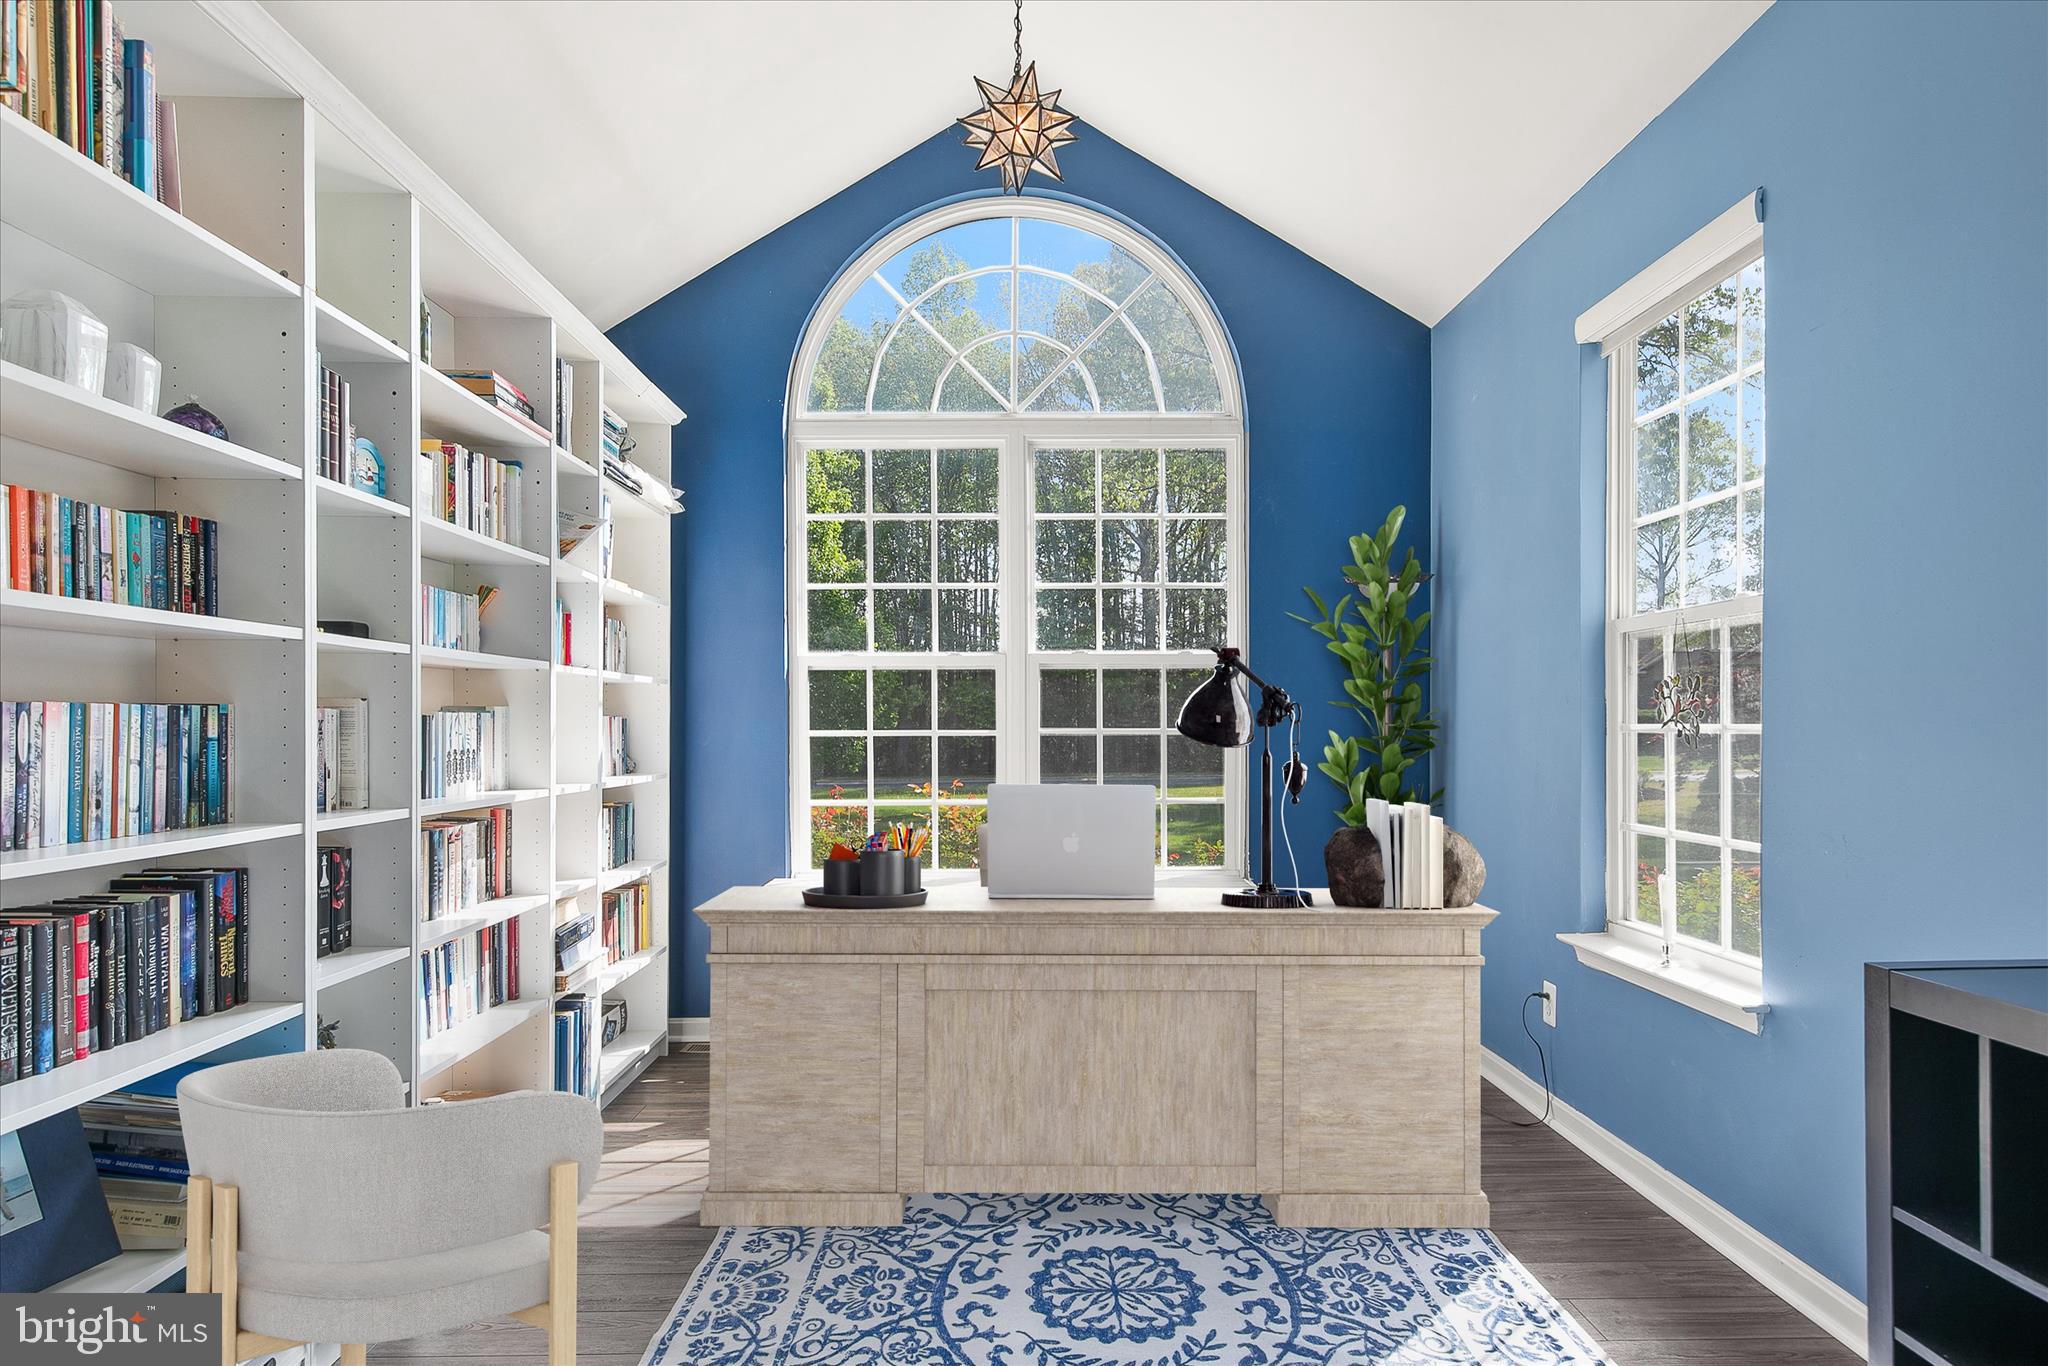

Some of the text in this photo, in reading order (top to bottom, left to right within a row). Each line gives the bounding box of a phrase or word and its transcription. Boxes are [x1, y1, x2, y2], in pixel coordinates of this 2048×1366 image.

[105, 47, 114, 169] GREAT GRILLING
[183, 543, 192, 586] PATTERSON
[74, 726, 82, 792] MEGAN HART
[62, 945, 72, 957] the
[161, 923, 170, 994] WATERFALL
[219, 934, 230, 977] THINGS
[227, 927, 236, 978] NEEDFUL
[62, 957, 71, 992] evolution
[88, 961, 96, 988] World
[108, 959, 116, 1000] Endure
[116, 954, 126, 995] Entice
[24, 975, 33, 1058] BLACK DUCK
